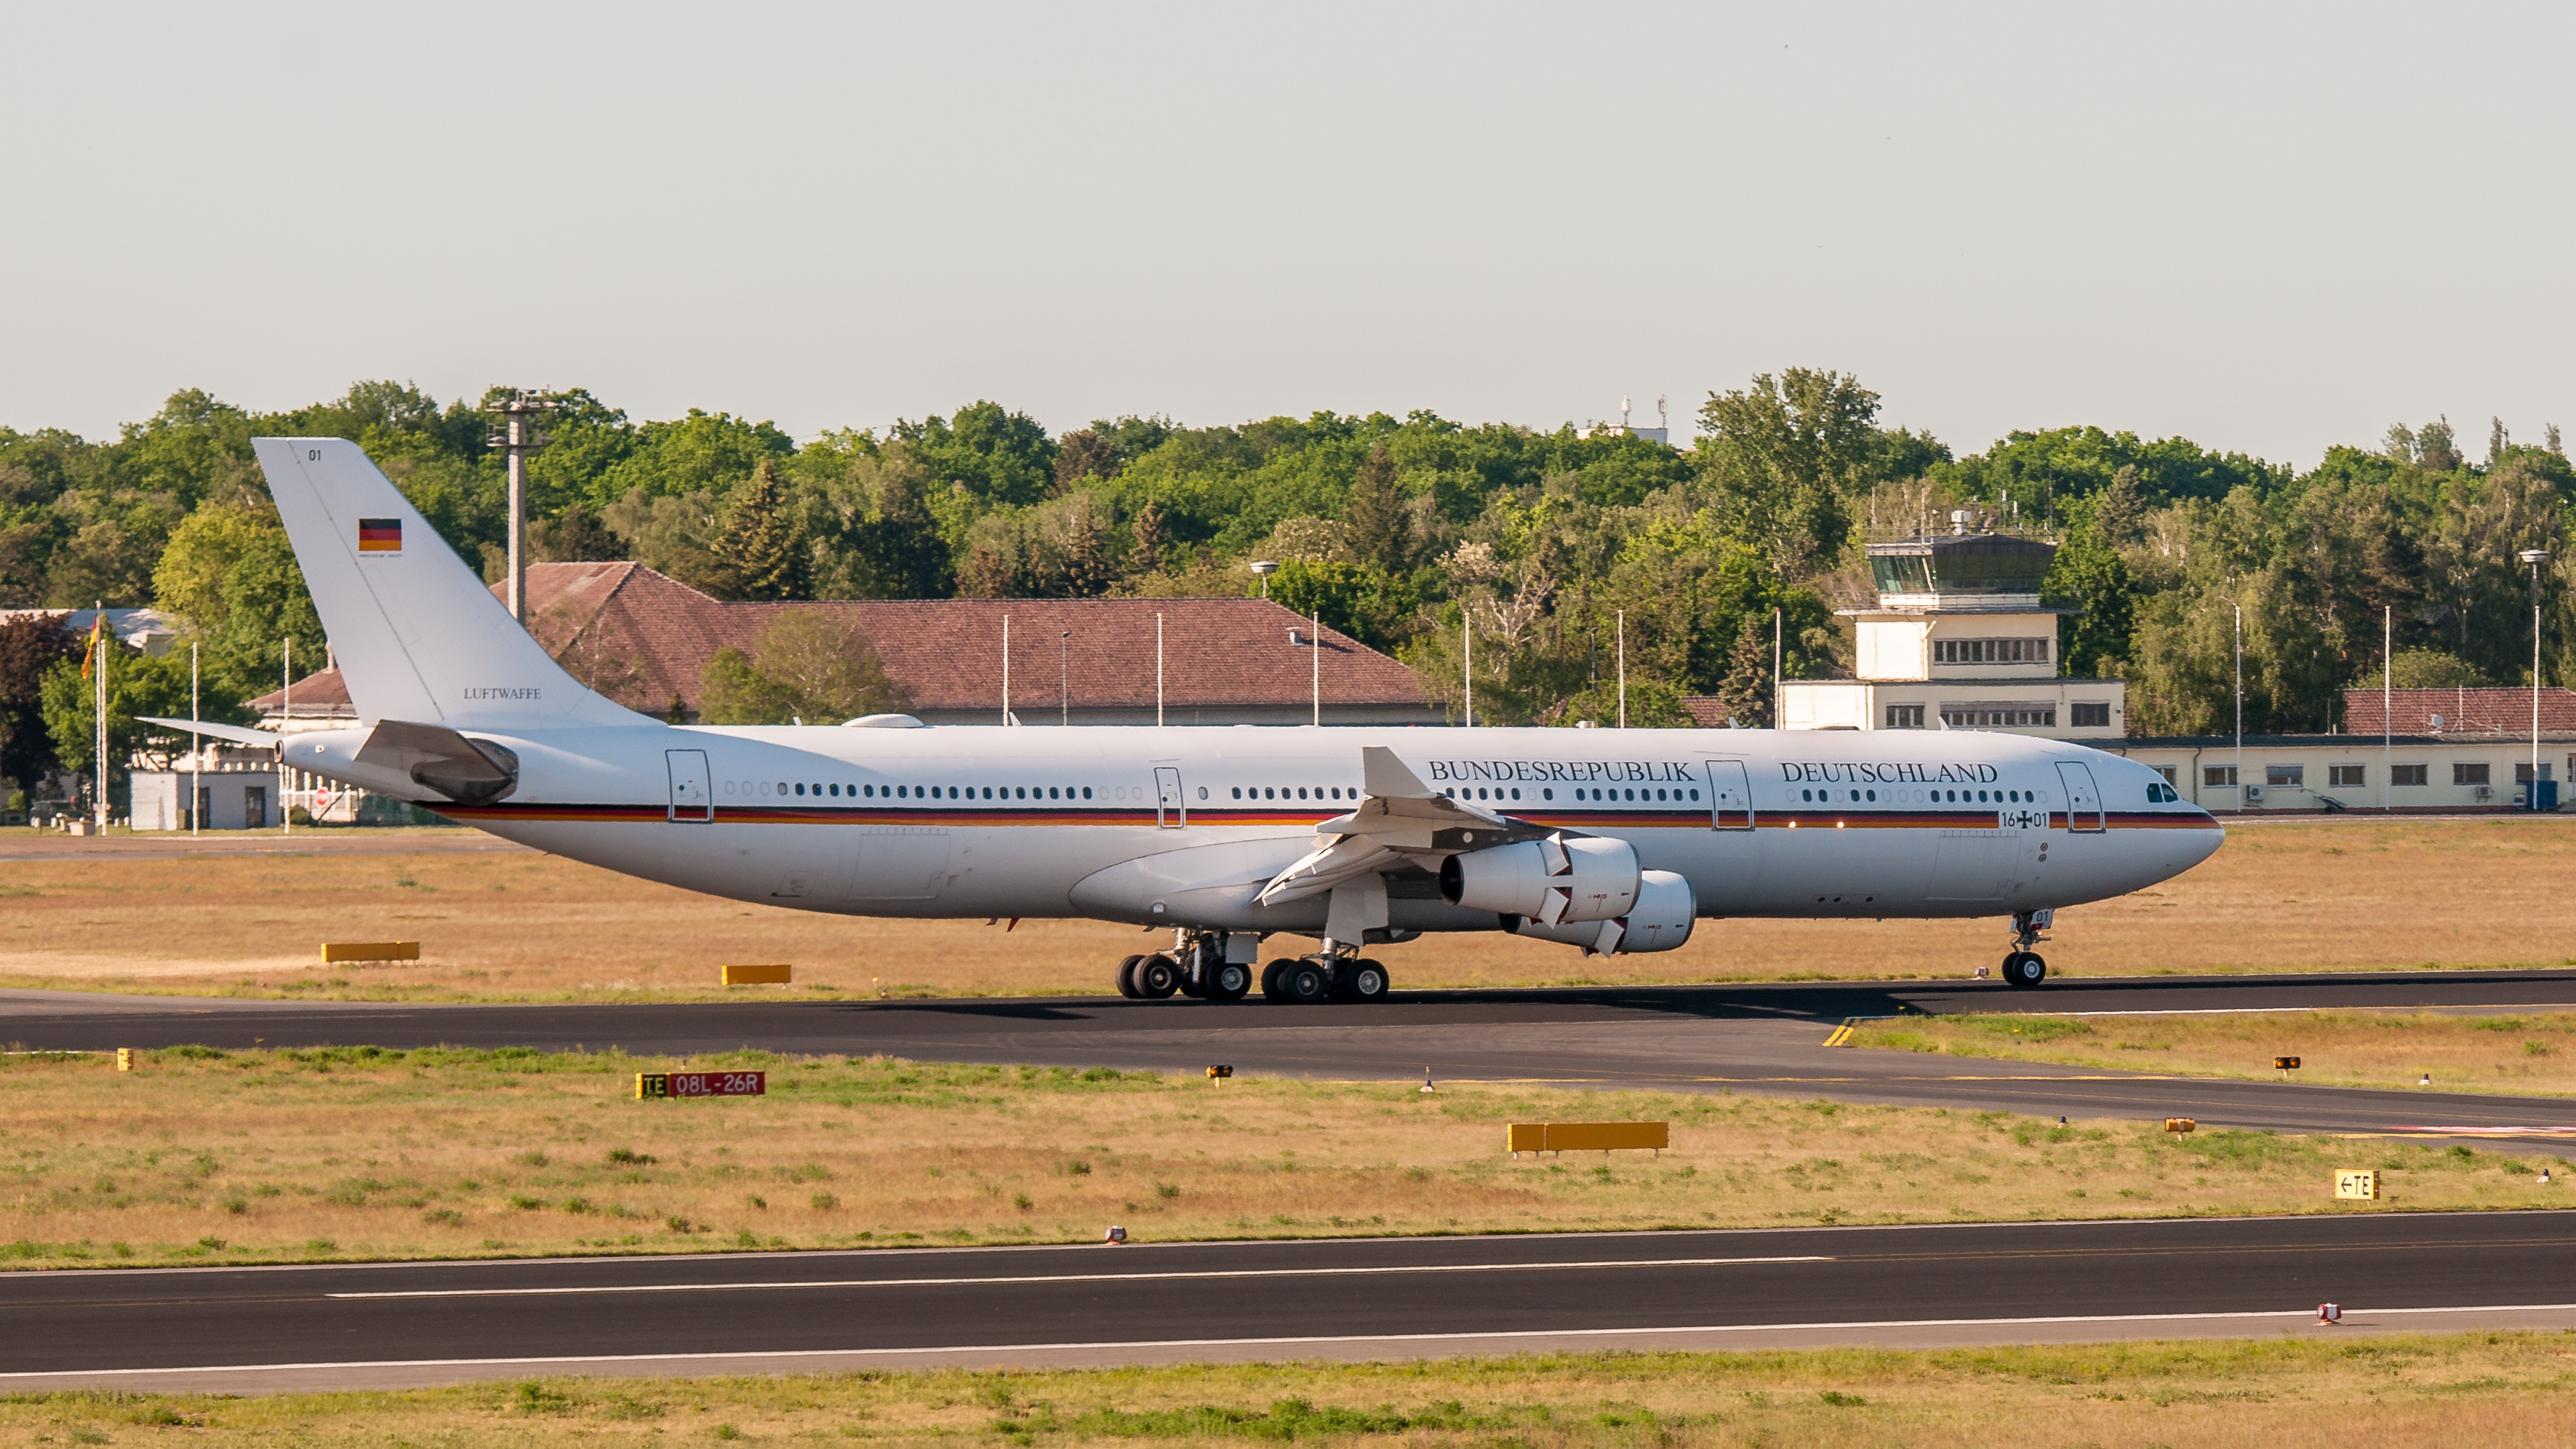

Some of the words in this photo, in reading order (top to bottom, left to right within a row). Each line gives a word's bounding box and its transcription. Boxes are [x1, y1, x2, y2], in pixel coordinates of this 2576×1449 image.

[309, 449, 321, 461] 01
[464, 688, 542, 700] LUFTWAFFE
[1429, 761, 1696, 782] BUNDESREPUBLIK
[1779, 762, 1997, 783] DEUTSCHLAND
[2002, 811, 2015, 827] 16
[2034, 812, 2047, 827] 01
[2036, 910, 2049, 922] 01
[643, 1077, 665, 1095] TE
[676, 1074, 758, 1093] 08L-26R
[2354, 1176, 2370, 1196] TE
